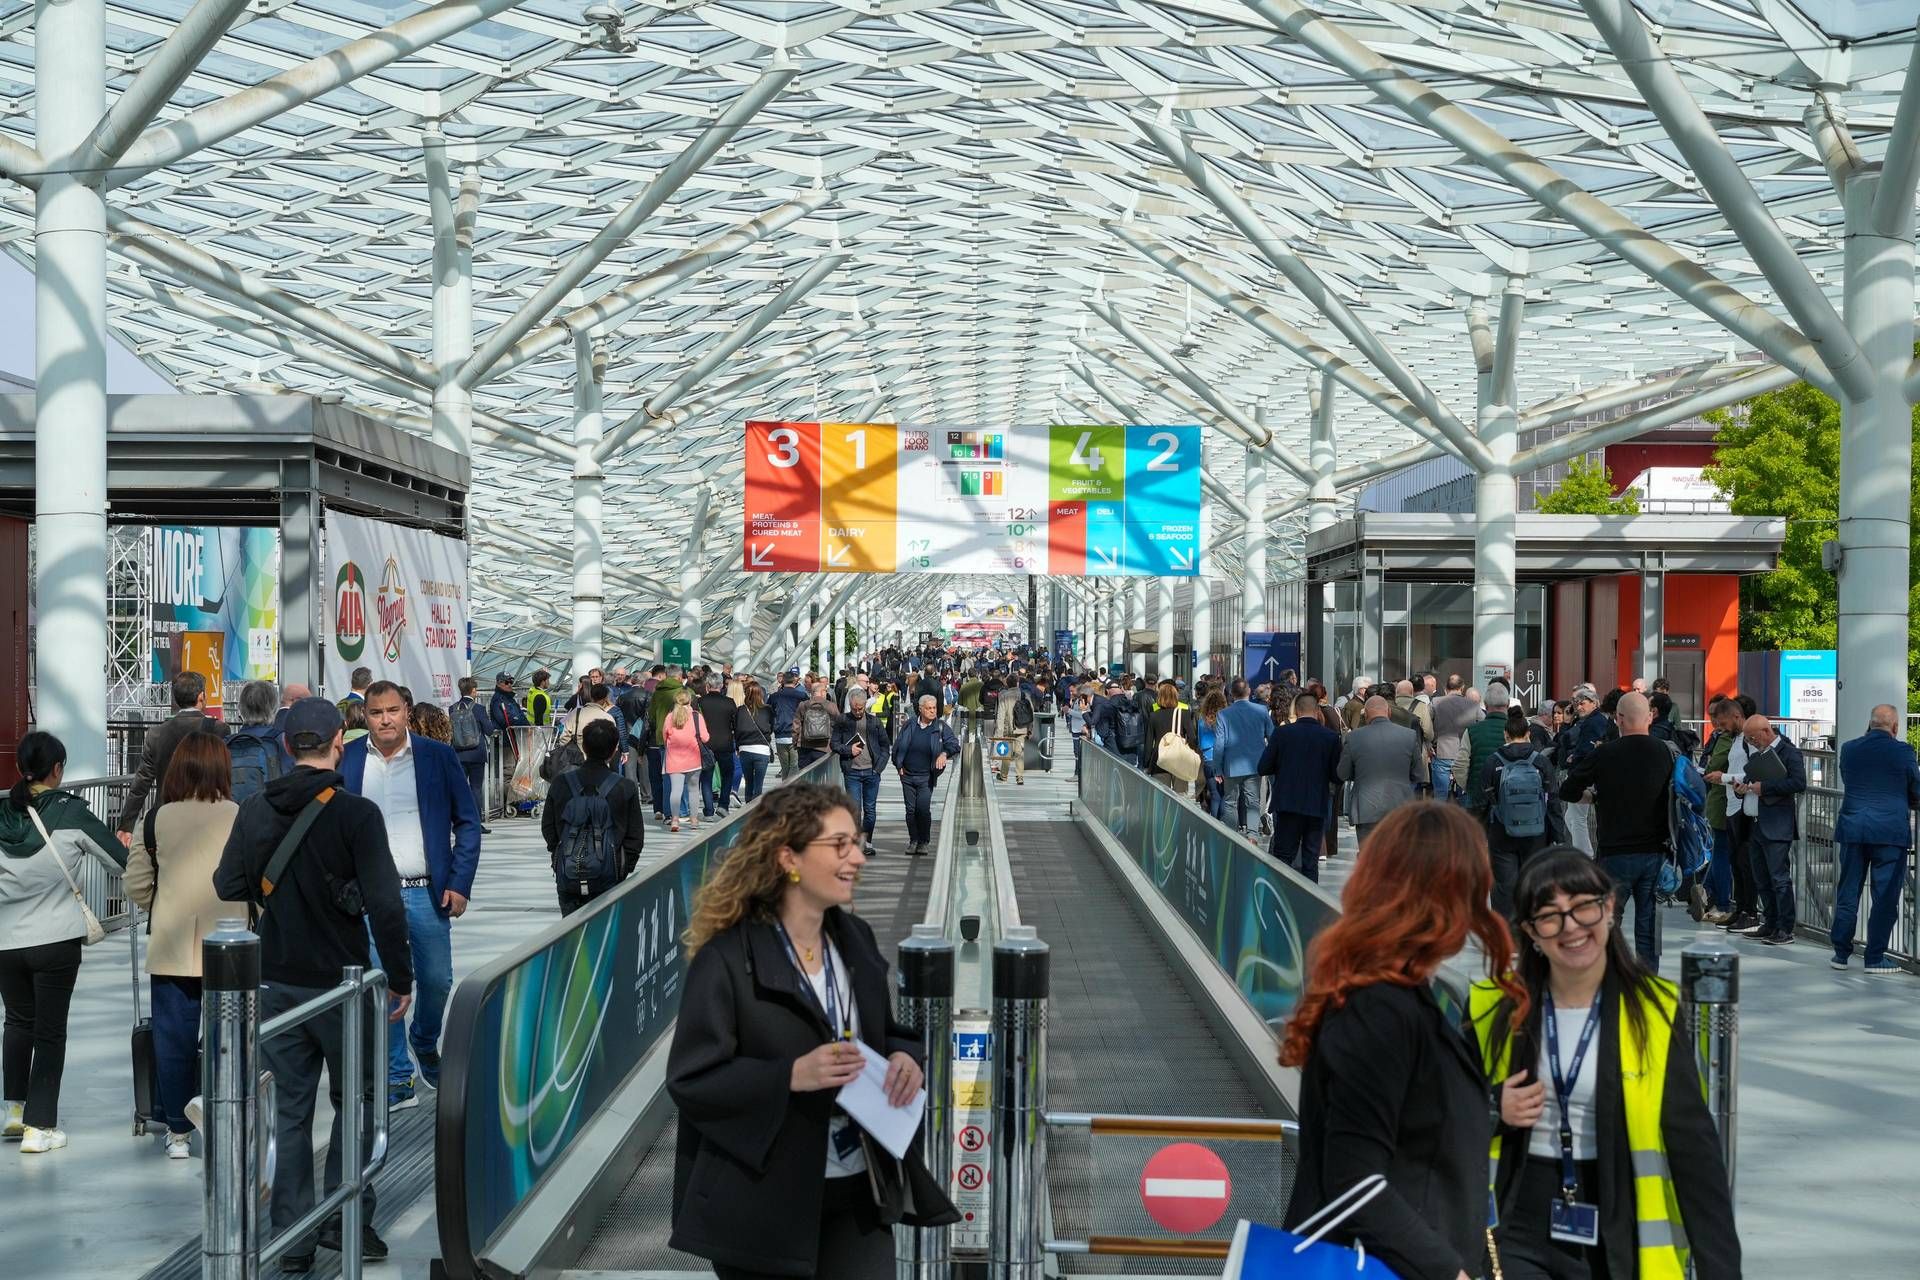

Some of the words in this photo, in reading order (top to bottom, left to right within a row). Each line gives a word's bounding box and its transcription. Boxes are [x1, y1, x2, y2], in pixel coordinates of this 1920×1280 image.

[950, 432, 959, 440] 12
[767, 428, 800, 468] 3
[845, 429, 866, 469] 1
[1069, 431, 1105, 472] 4
[1146, 432, 1180, 472] 2
[752, 513, 776, 521] MEAT,
[1008, 508, 1025, 520] 12
[1056, 508, 1079, 516] MEAT
[1096, 508, 1114, 516] DELI
[752, 521, 791, 529] PROTEINS
[792, 521, 799, 529] &
[1006, 524, 1025, 536] 10
[751, 529, 779, 537] CURED
[780, 529, 803, 537] MEAT
[828, 528, 866, 537] DAIRY
[920, 540, 930, 551] 7
[153, 527, 204, 607] MORE
[919, 556, 930, 568] 5
[1014, 556, 1024, 568] 6
[336, 590, 365, 637] AIA
[377, 594, 405, 636] Negroni
[431, 603, 446, 624] HALL
[425, 627, 445, 648] STAND
[184, 639, 191, 670] 1
[1802, 689, 1823, 697] 1936
